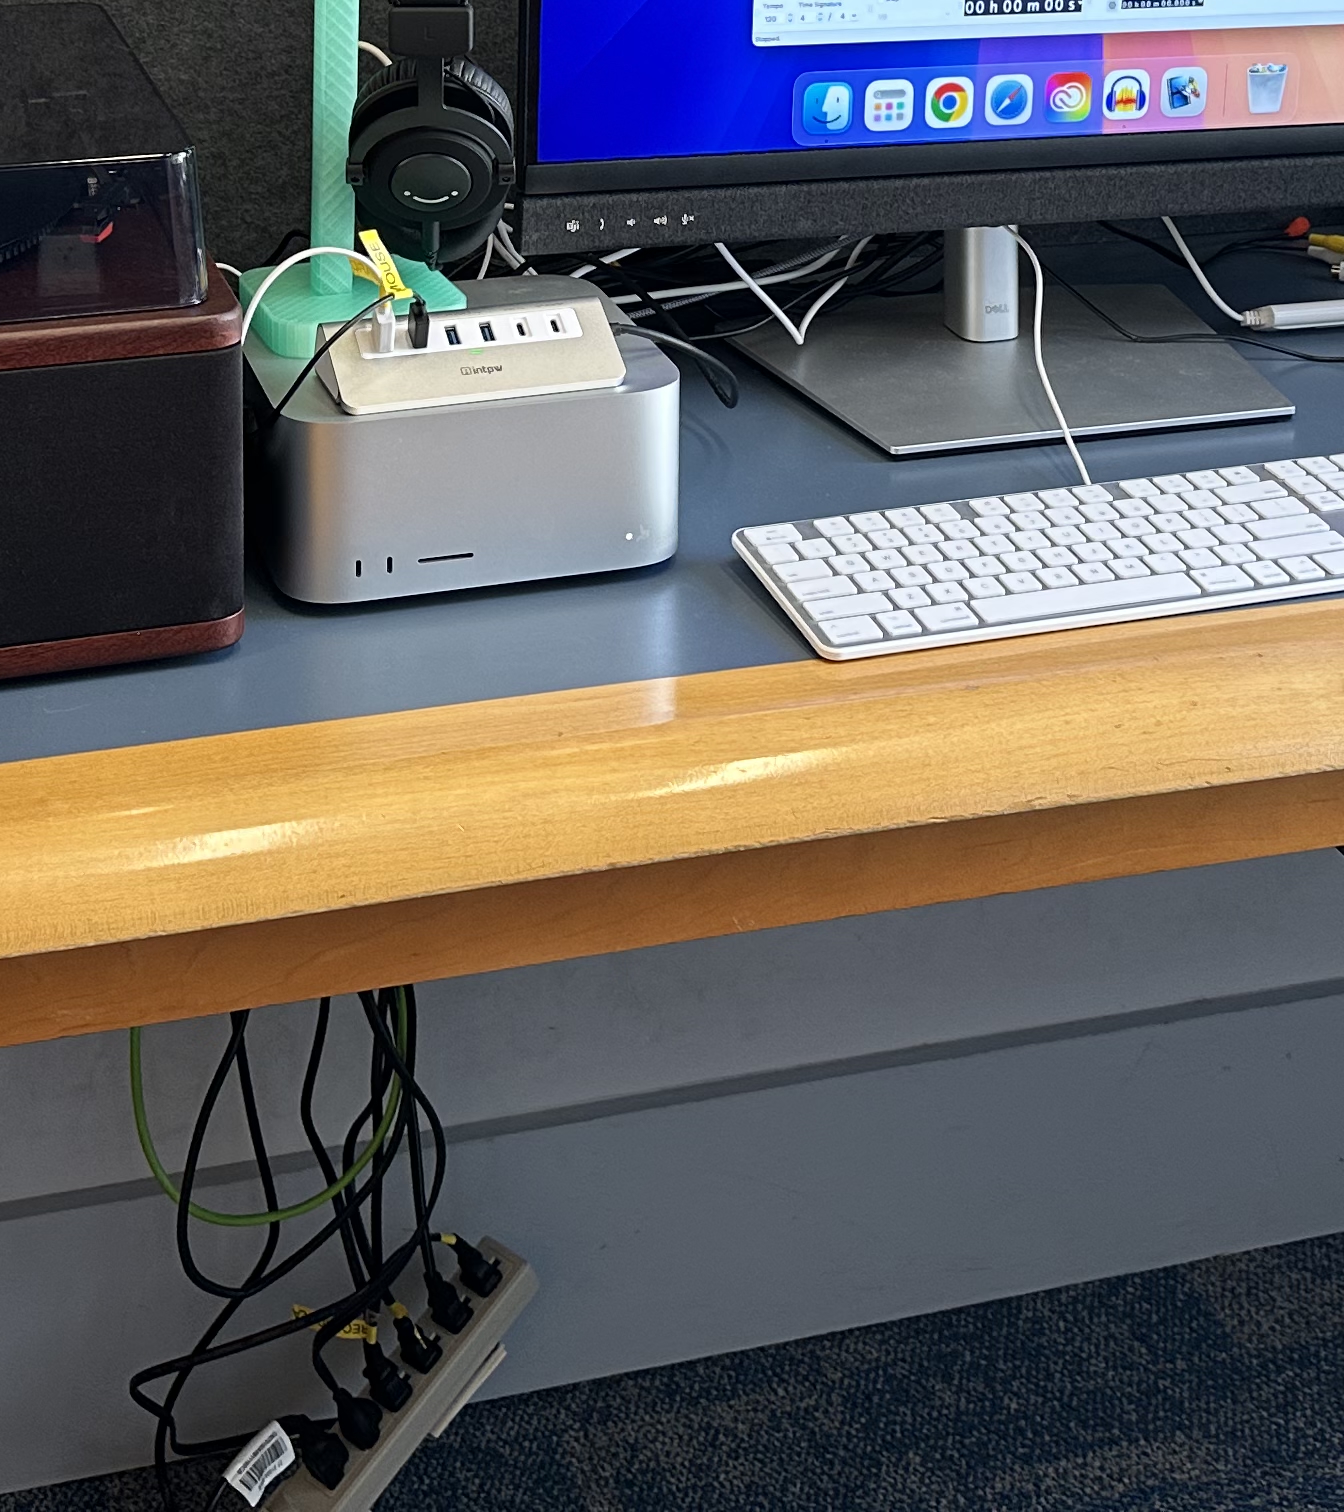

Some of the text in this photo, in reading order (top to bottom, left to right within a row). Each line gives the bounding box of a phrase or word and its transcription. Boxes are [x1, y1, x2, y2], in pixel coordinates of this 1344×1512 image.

[965, 1, 985, 14] 00
[989, 0, 998, 13] h
[1002, 0, 1023, 13] 00
[1027, 2, 1040, 12] m
[1068, 1, 1076, 11] s
